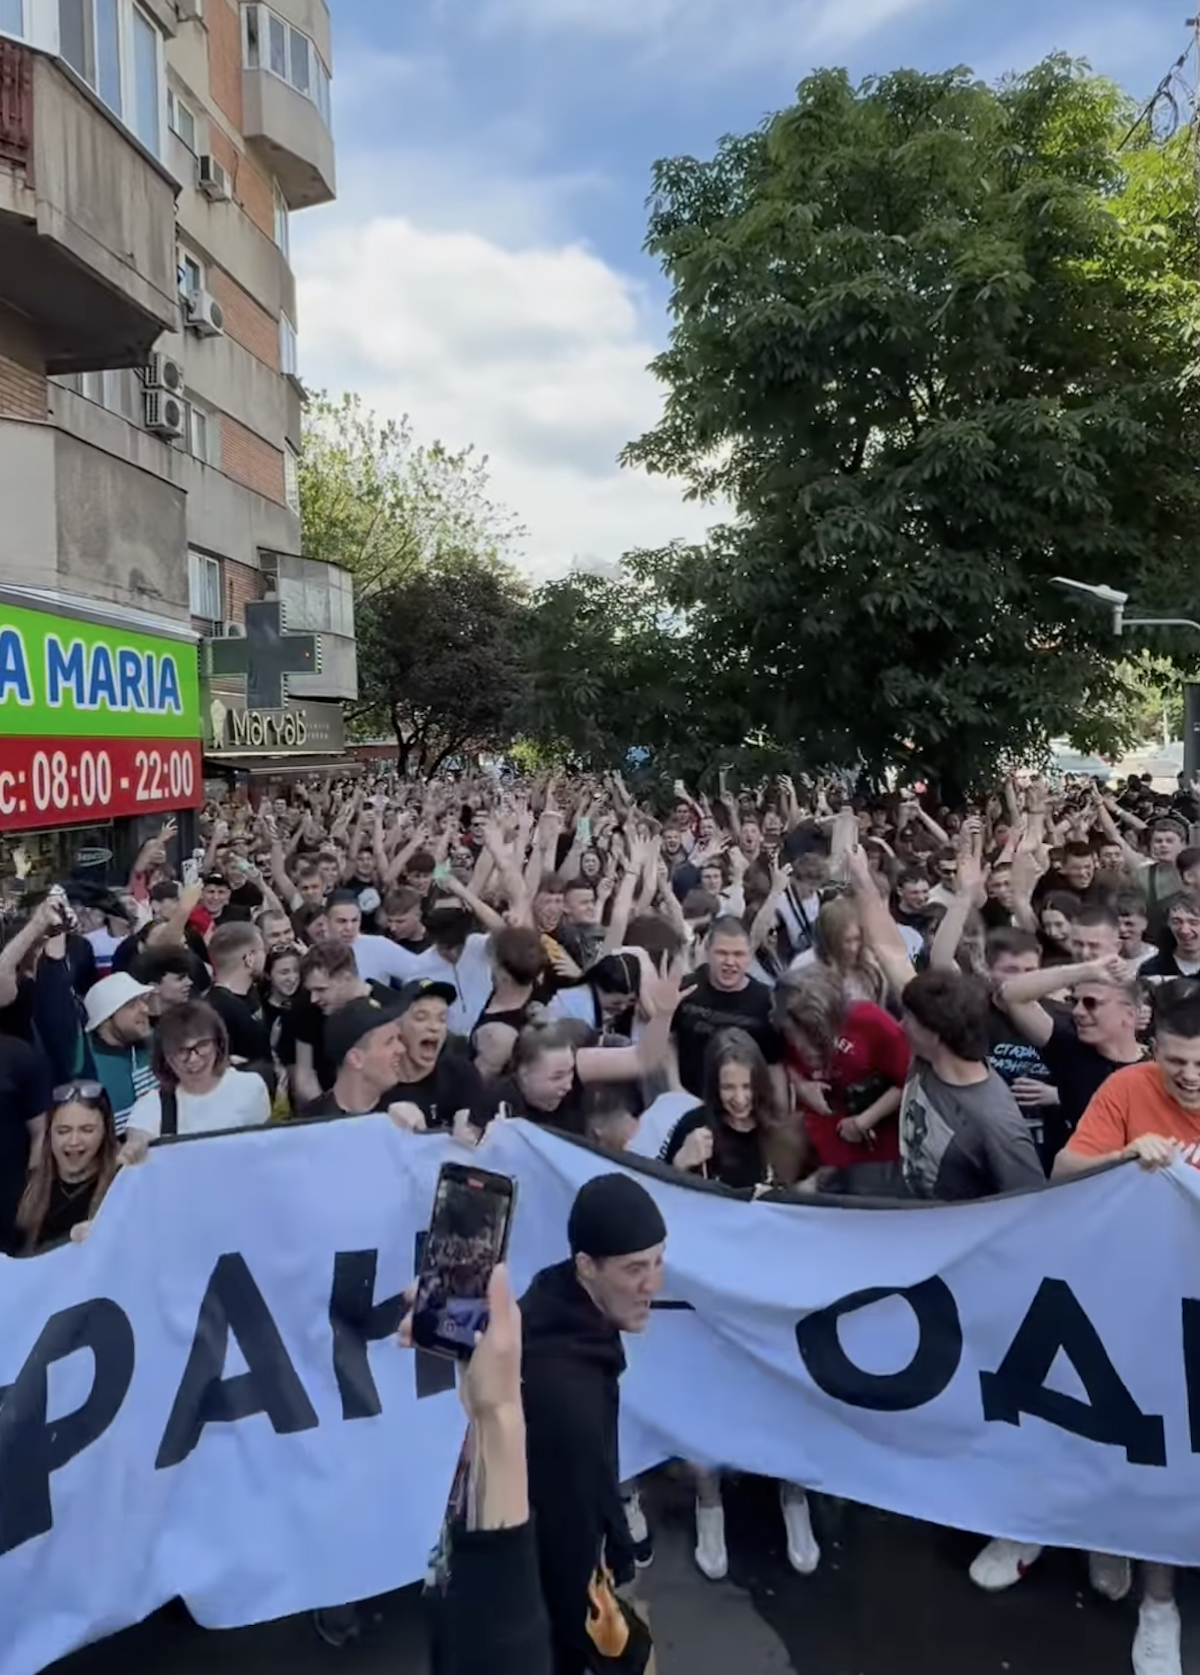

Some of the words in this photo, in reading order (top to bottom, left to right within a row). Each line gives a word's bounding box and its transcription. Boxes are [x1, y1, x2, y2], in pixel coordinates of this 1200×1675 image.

[46, 634, 183, 714] MARIA
[32, 751, 112, 811] 08:00
[120, 777, 129, 788] -
[135, 750, 193, 800] 22:00
[795, 1274, 1200, 1467] ОД
